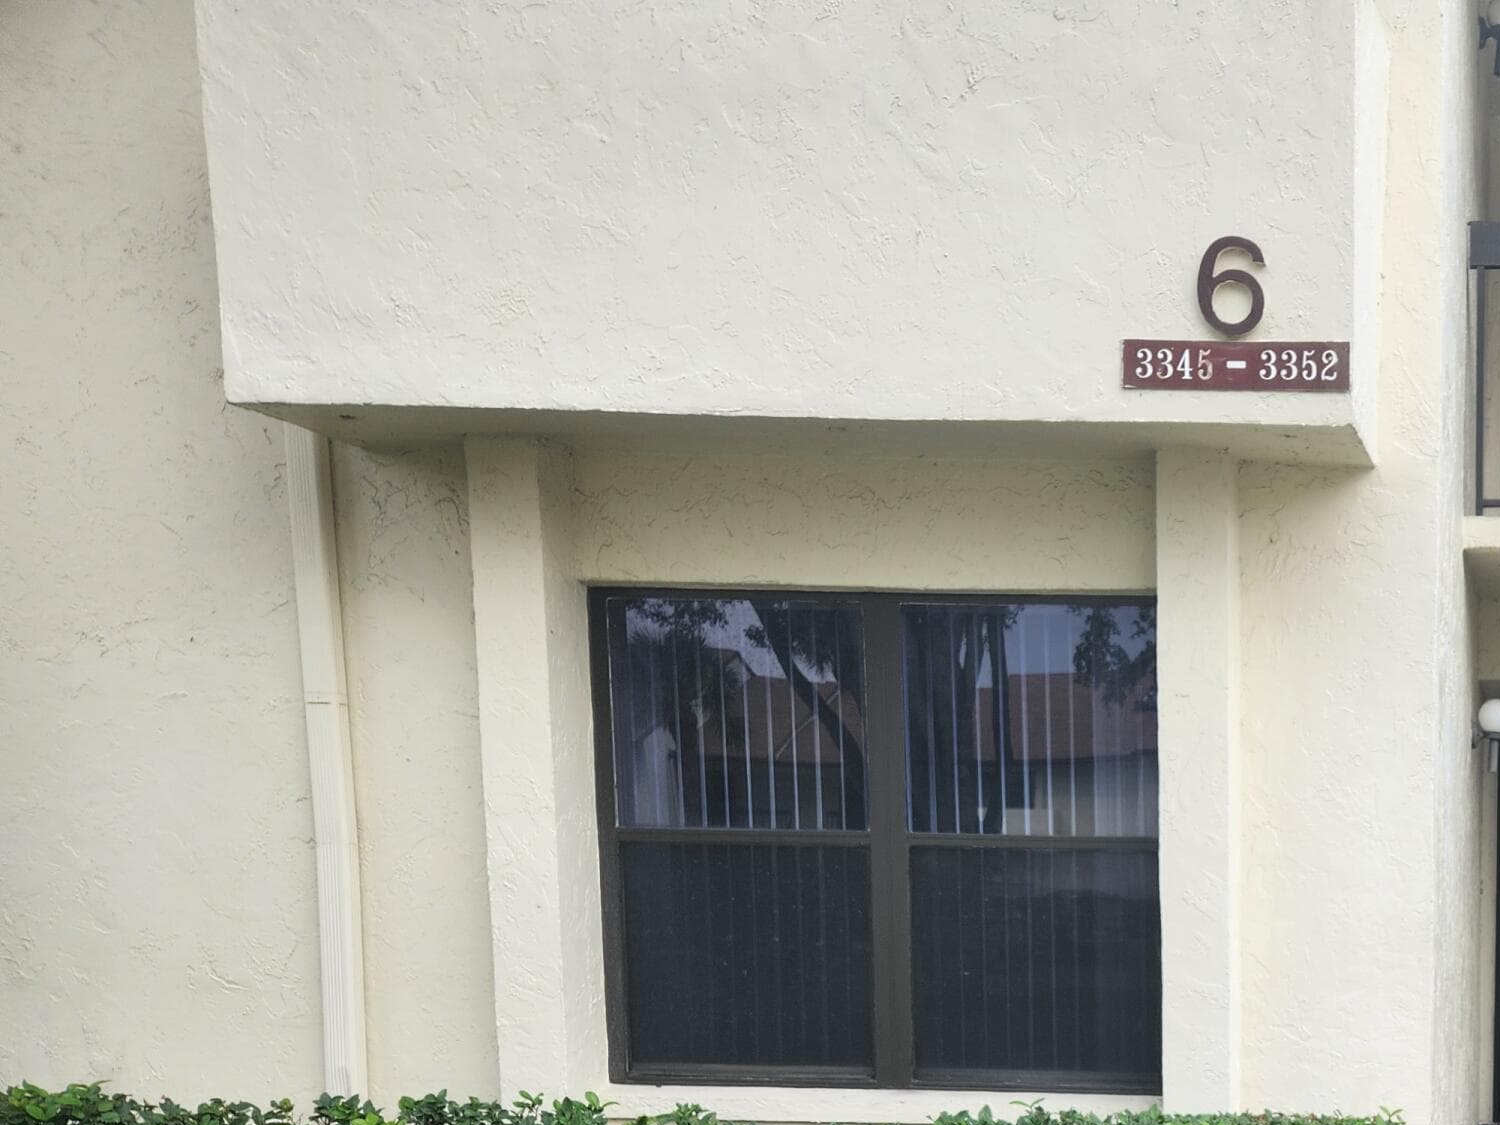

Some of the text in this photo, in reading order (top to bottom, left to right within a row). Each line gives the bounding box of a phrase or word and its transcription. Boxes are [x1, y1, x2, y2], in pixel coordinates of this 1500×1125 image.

[1197, 236, 1265, 335] 6
[1135, 349, 1213, 380] 3345
[1259, 350, 1338, 380] 3352
